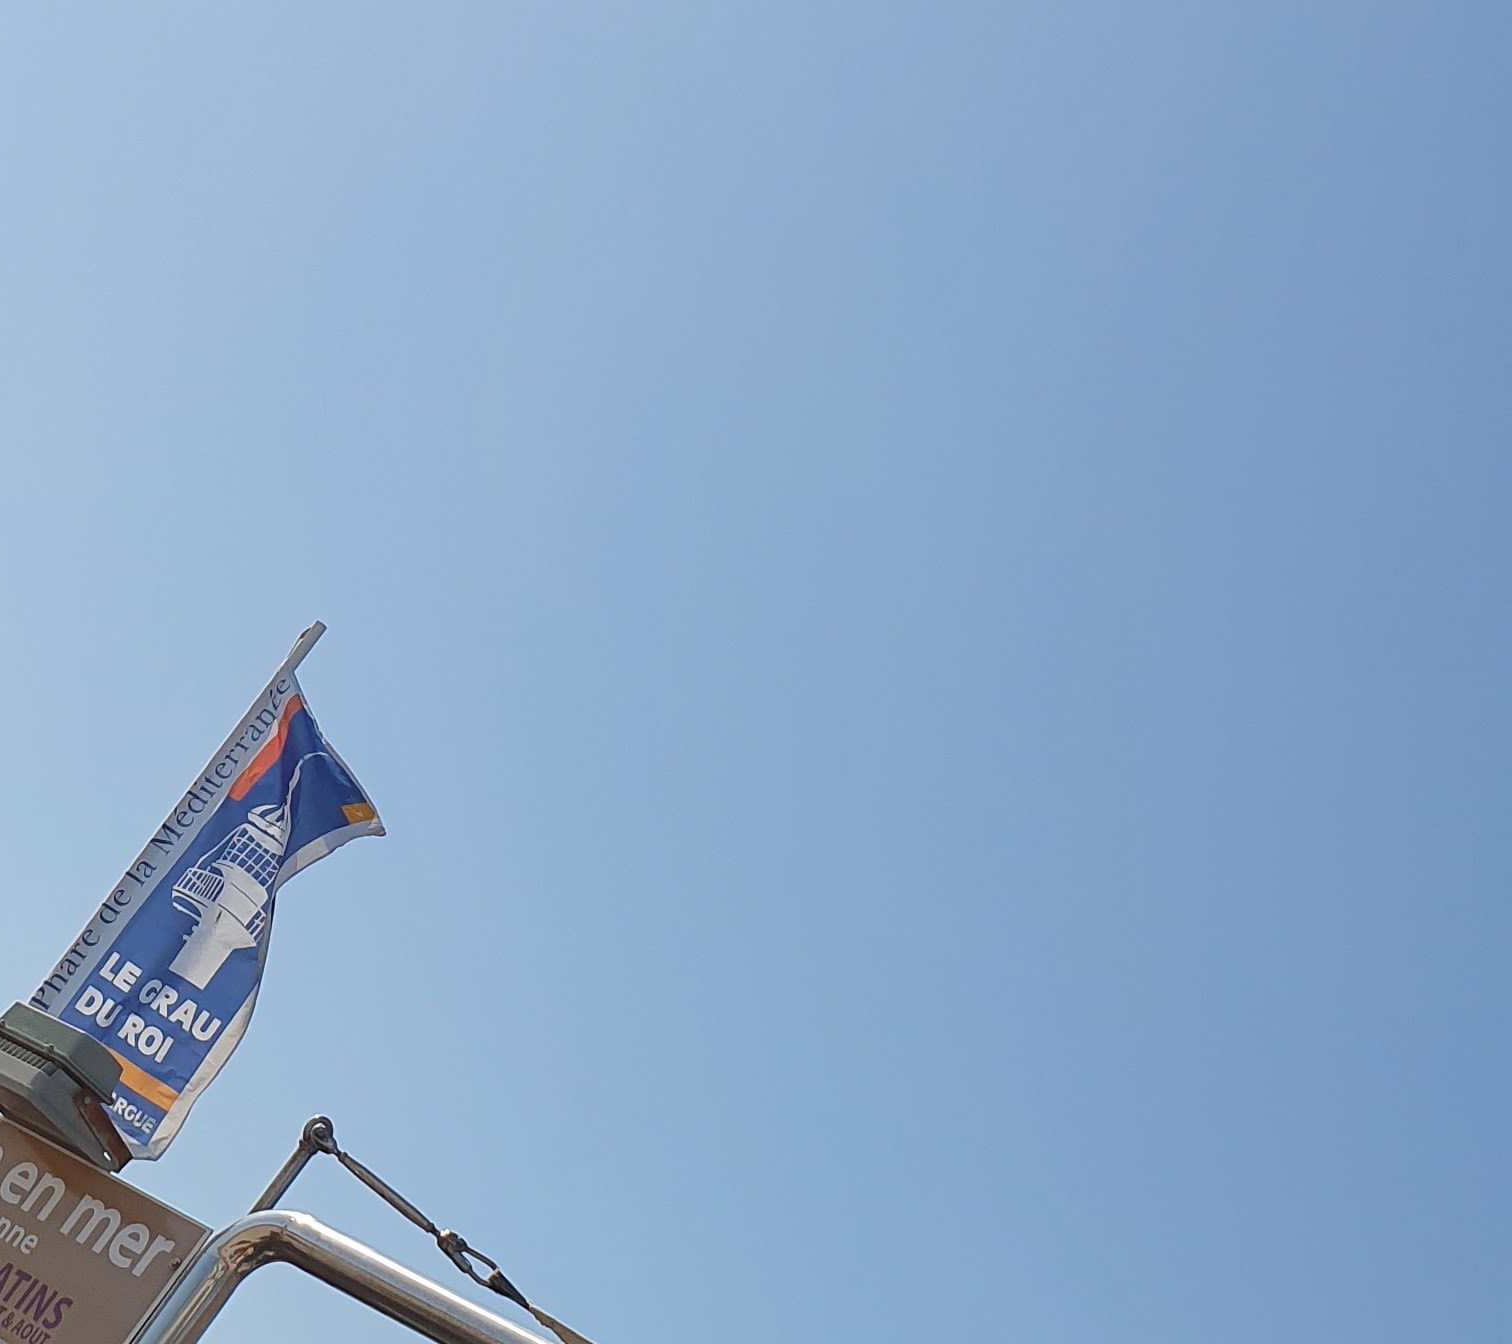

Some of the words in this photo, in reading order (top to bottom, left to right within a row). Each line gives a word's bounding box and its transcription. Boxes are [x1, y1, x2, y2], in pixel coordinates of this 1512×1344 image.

[30, 926, 100, 1013] Phare
[100, 886, 133, 926] de
[132, 855, 159, 887] la
[74, 984, 124, 1029] DU
[117, 1012, 176, 1065] ROI
[99, 951, 144, 994] LE
[139, 978, 223, 1044] GRAU
[60, 1194, 175, 1278] mer
[0, 1311, 16, 1330] &
